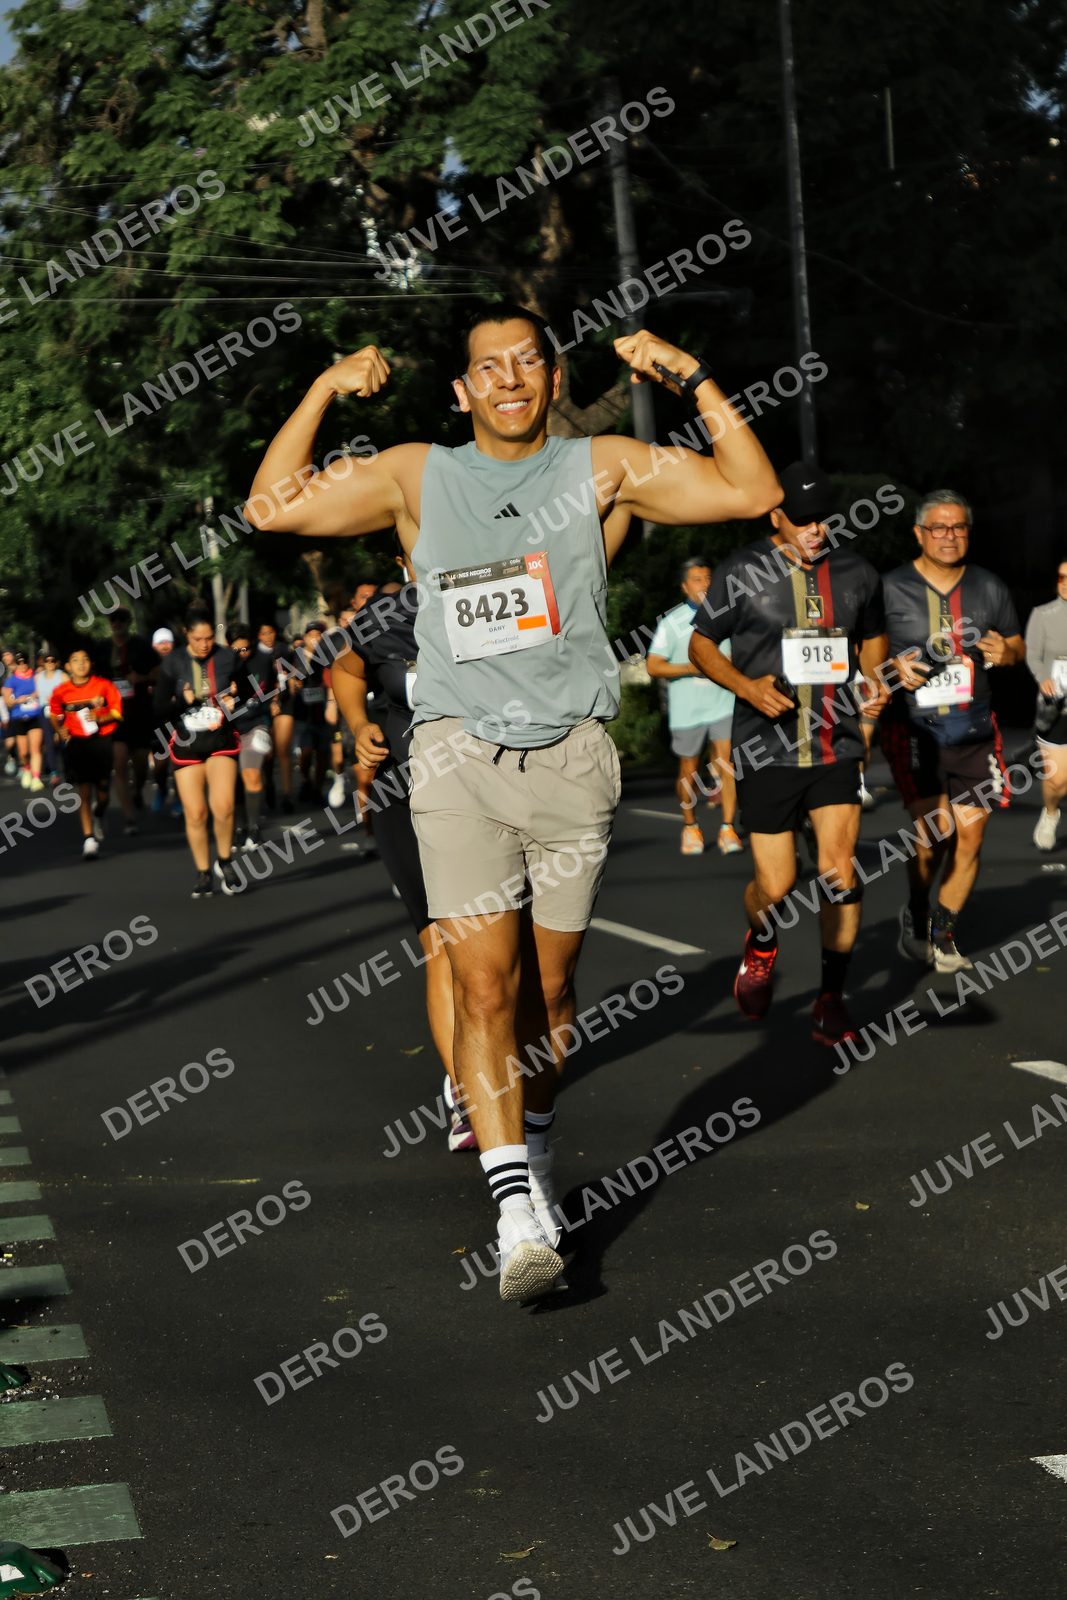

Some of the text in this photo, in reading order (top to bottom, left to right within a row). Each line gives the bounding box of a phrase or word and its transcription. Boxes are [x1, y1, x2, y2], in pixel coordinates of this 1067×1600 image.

[455, 587, 530, 628] 8423
[488, 625, 506, 633] DANY
[802, 645, 833, 663] 918
